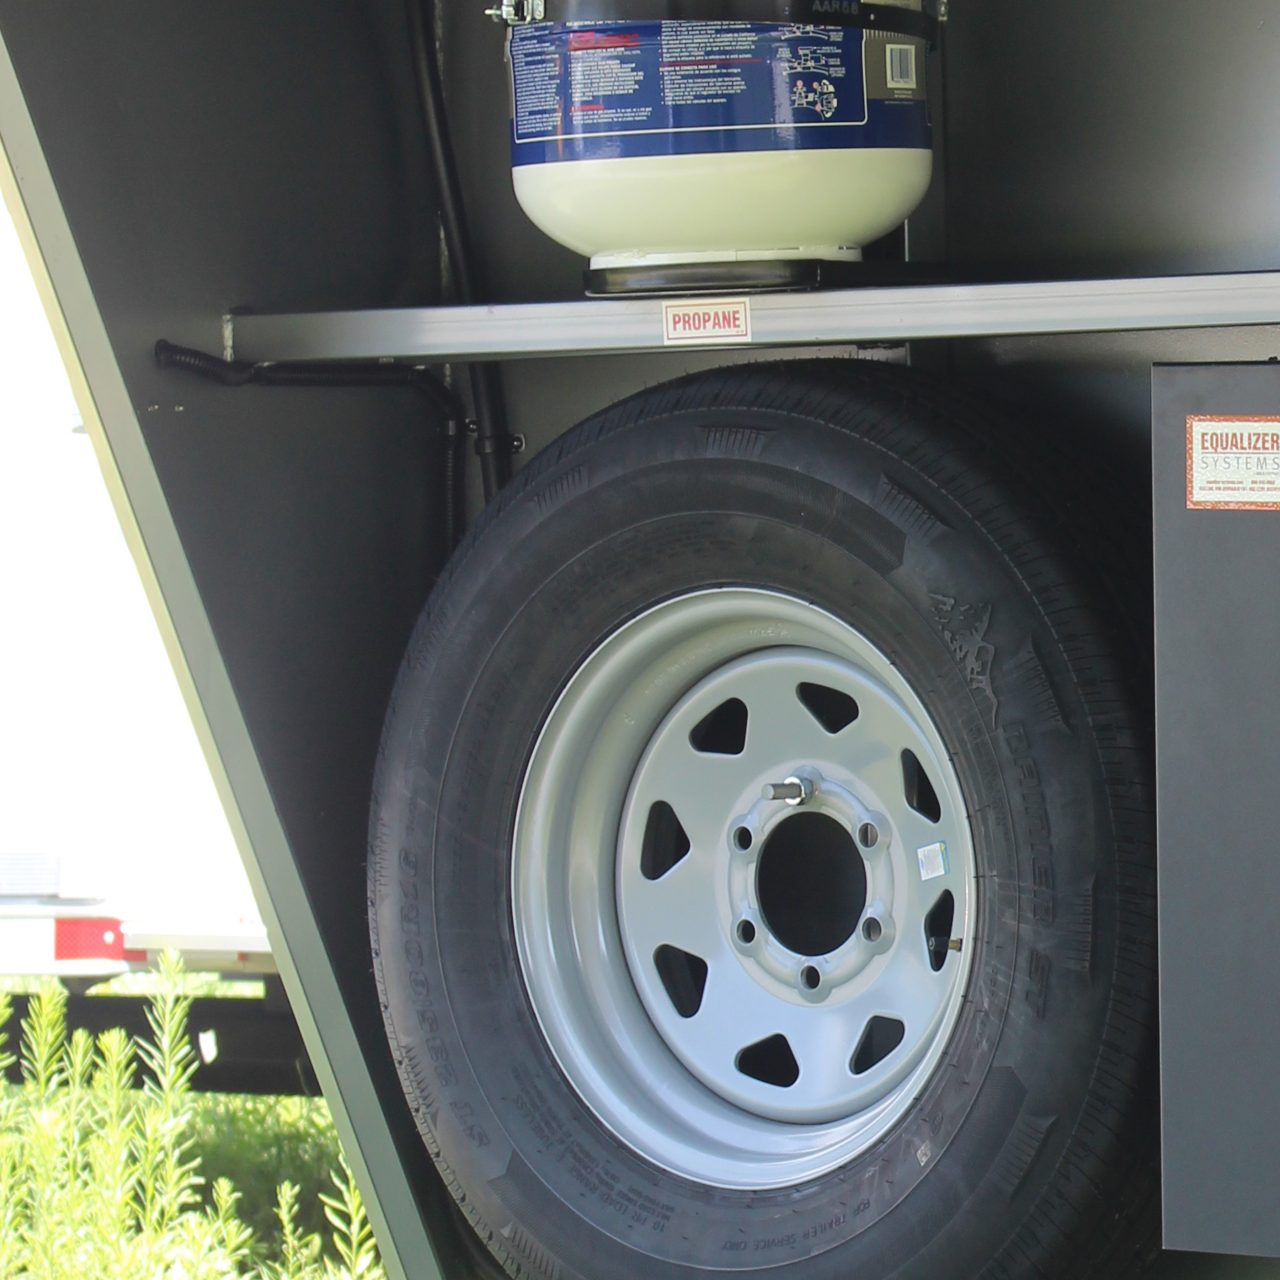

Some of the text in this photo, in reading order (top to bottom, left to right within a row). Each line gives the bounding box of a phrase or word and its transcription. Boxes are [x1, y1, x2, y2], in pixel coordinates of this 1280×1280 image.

[672, 310, 741, 332] PROPANE
[1201, 432, 1280, 452] EQUALIZER
[1200, 456, 1280, 470] SYSTEMS
[450, 1101, 491, 1147] ST
[600, 1193, 629, 1215] LOAD
[722, 1198, 871, 1251] FOR TRAILER SERVICE ONLY
